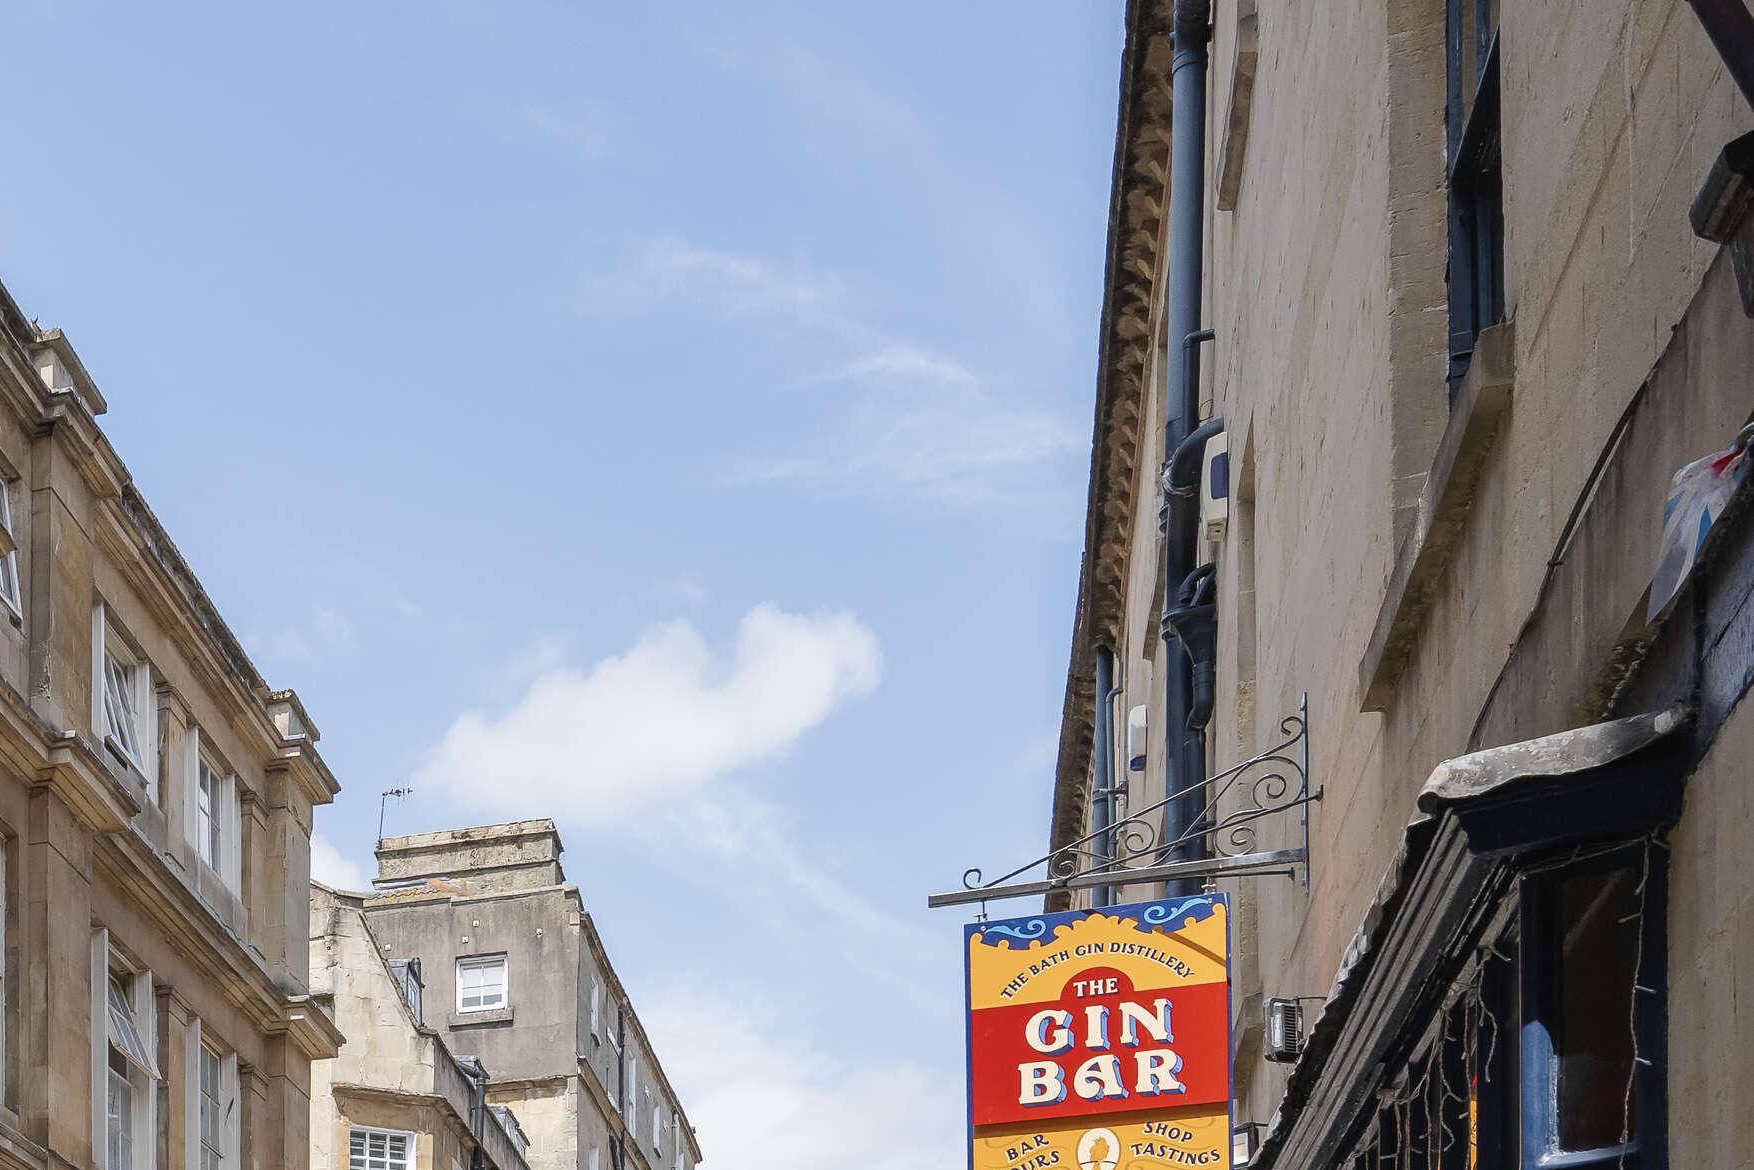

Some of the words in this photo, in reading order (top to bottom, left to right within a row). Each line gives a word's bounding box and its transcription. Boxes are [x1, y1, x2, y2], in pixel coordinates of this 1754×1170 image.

[1000, 973, 1029, 1001] THE
[1030, 949, 1070, 976] BATH
[1075, 942, 1105, 958] GIN
[1109, 941, 1196, 979] DISTILLERY
[1073, 977, 1119, 997] THE
[1025, 998, 1174, 1056] GIN
[1017, 1048, 1187, 1107] BAR
[1143, 1121, 1193, 1143] SHOP
[1007, 1133, 1050, 1161] BAR
[1130, 1142, 1221, 1166] TASTINGS
